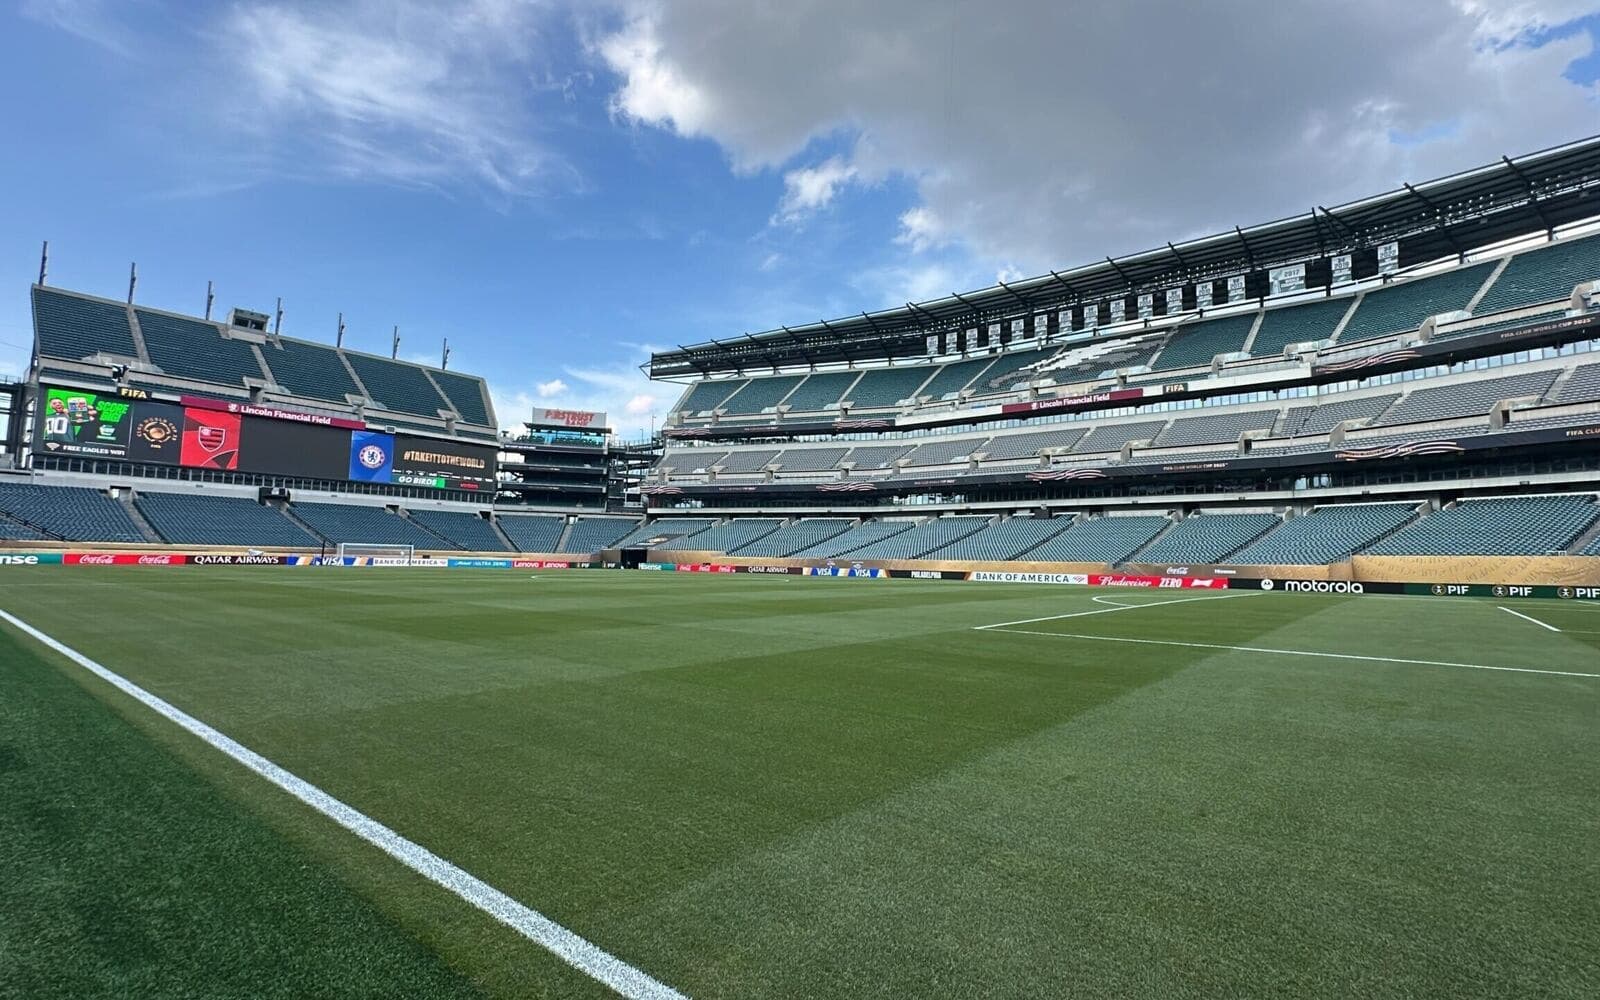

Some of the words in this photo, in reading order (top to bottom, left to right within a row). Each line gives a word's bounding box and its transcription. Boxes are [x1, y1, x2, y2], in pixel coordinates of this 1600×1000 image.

[1533, 324, 1558, 333] WORLD
[1558, 321, 1573, 329] CUP
[120, 388, 147, 400] FIFA
[1166, 384, 1184, 394] FIFA
[1039, 400, 1063, 408] Lincoln
[1064, 396, 1092, 405] Financial
[1092, 394, 1110, 402] Field
[240, 404, 273, 417] Lincoln
[273, 410, 311, 422] Financial
[311, 416, 331, 424] Field
[403, 450, 485, 469] #TAKEITTOTHEWORLD
[80, 554, 115, 564] Coca-Cola
[138, 556, 171, 564] Coca-Cola
[194, 556, 232, 565] QATAR
[322, 556, 344, 566] VISA
[816, 568, 832, 576] VISA
[855, 568, 870, 577] VISA
[976, 572, 1002, 580] BANK
[1020, 574, 1070, 582] AMERICA
[1099, 576, 1152, 586] Budweiser
[1158, 578, 1182, 588] ZERO
[1284, 579, 1364, 593] motorola
[1447, 585, 1470, 594] PIF
[1510, 586, 1534, 596] PIF
[1576, 587, 1600, 598] PIF
